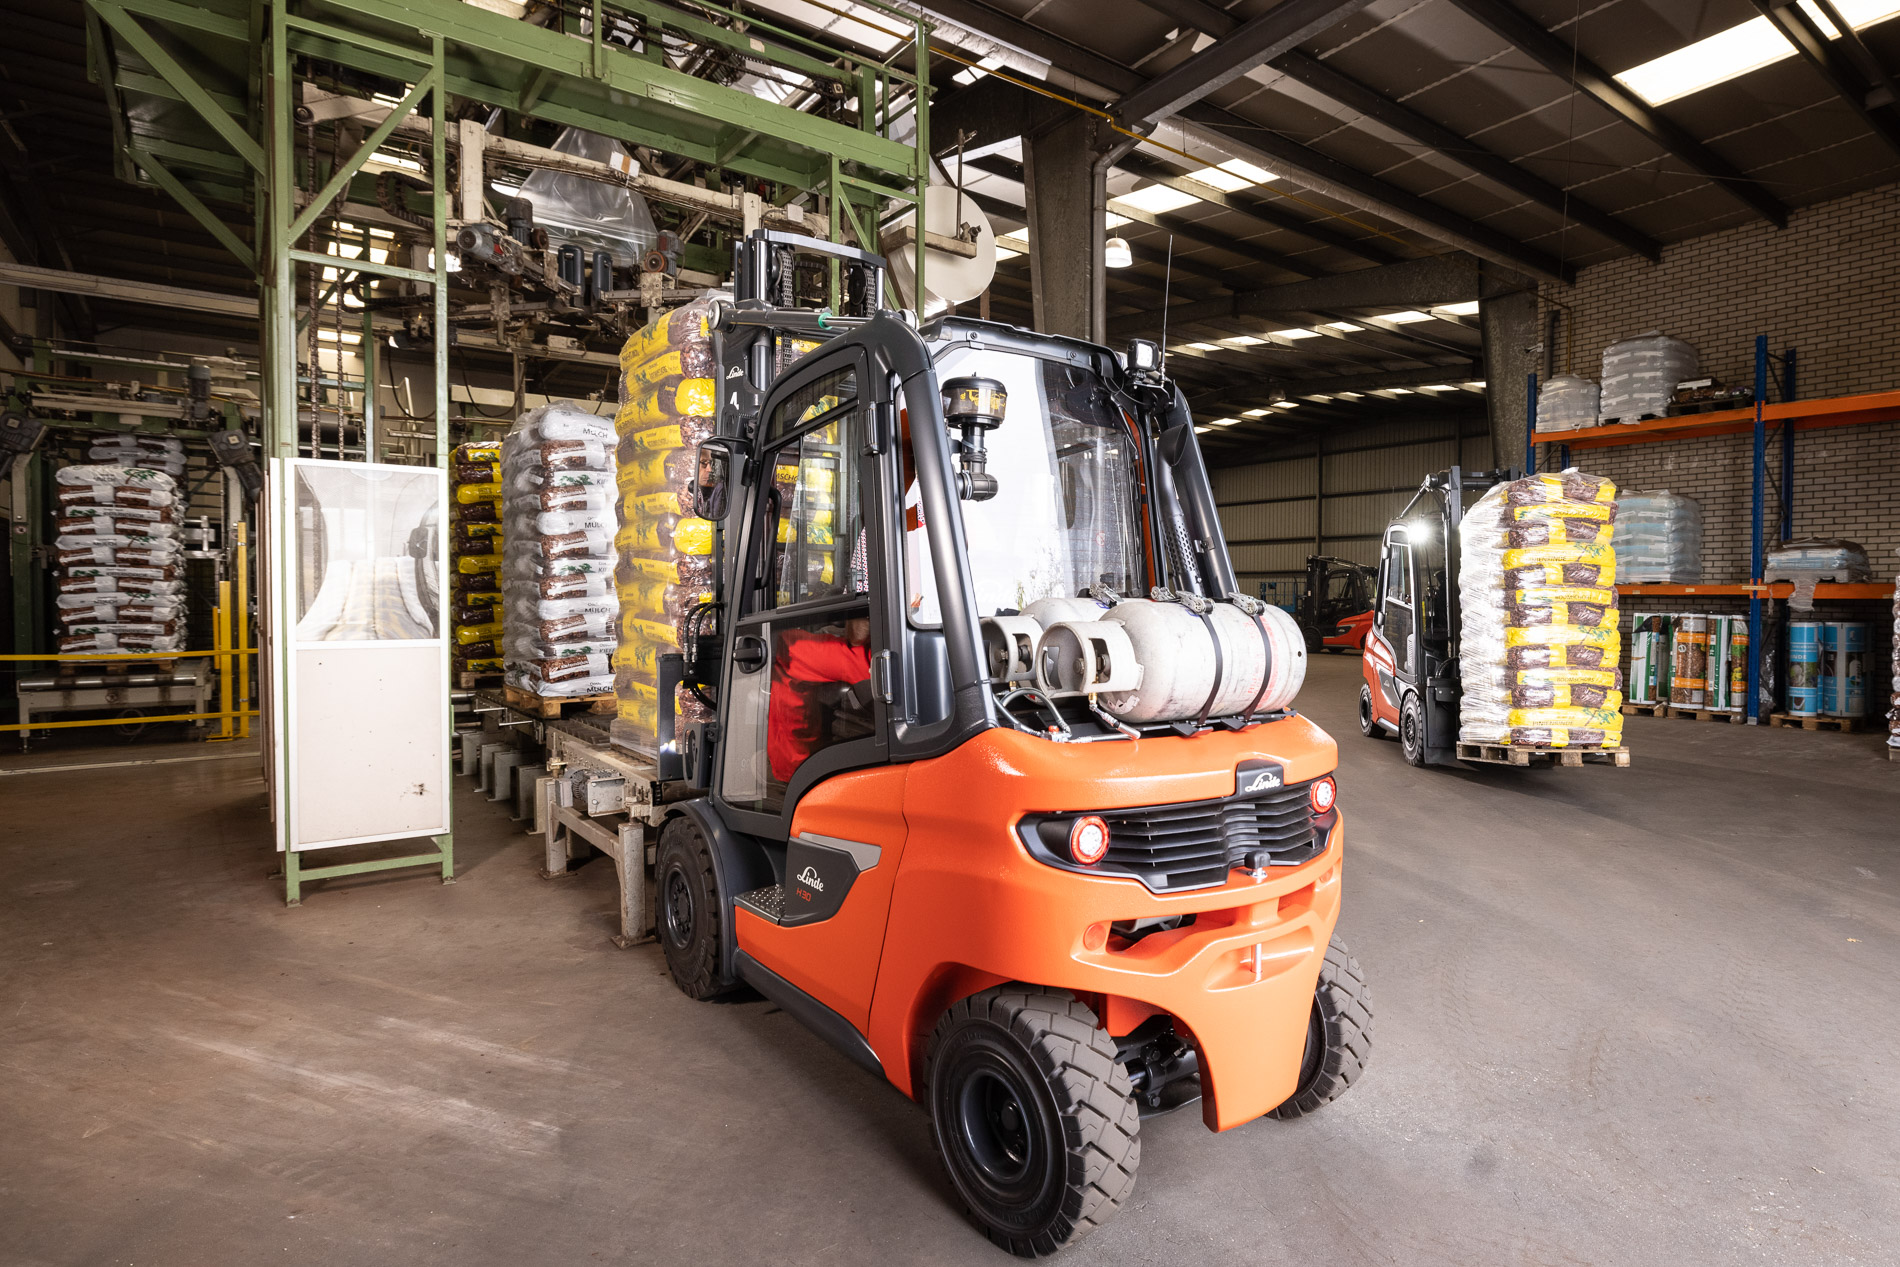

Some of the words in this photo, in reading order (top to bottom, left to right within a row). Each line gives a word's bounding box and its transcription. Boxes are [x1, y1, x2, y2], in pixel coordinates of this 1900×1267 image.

[726, 365, 744, 380] Linde
[1245, 772, 1281, 793] Linde
[796, 865, 824, 892] Linde
[795, 887, 812, 902] H30
